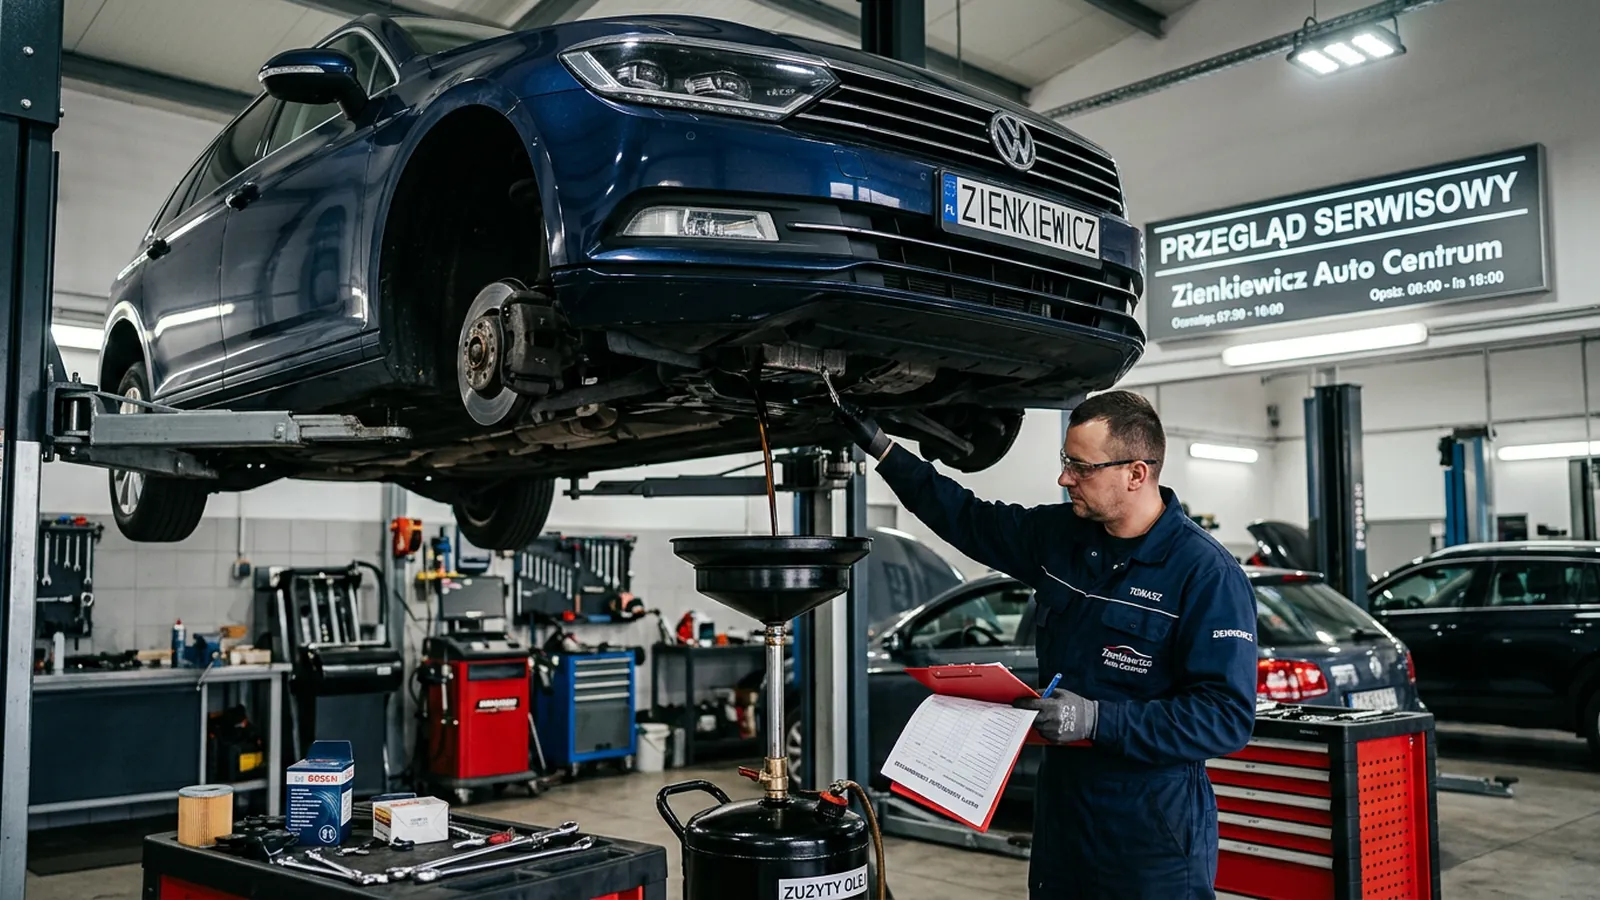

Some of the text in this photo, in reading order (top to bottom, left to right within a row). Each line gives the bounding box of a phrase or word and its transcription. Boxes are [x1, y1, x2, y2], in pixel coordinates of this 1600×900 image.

[961, 184, 1097, 255] ZIENKIEWICZ
[1160, 171, 1519, 265] PRZEGLĄD SERWISOWY
[1171, 239, 1504, 309] Zienkiewicz Auto Centrum
[1468, 270, 1505, 287] 18:00
[1130, 586, 1163, 602] TOMASZ
[844, 872, 867, 892] OLEJ
